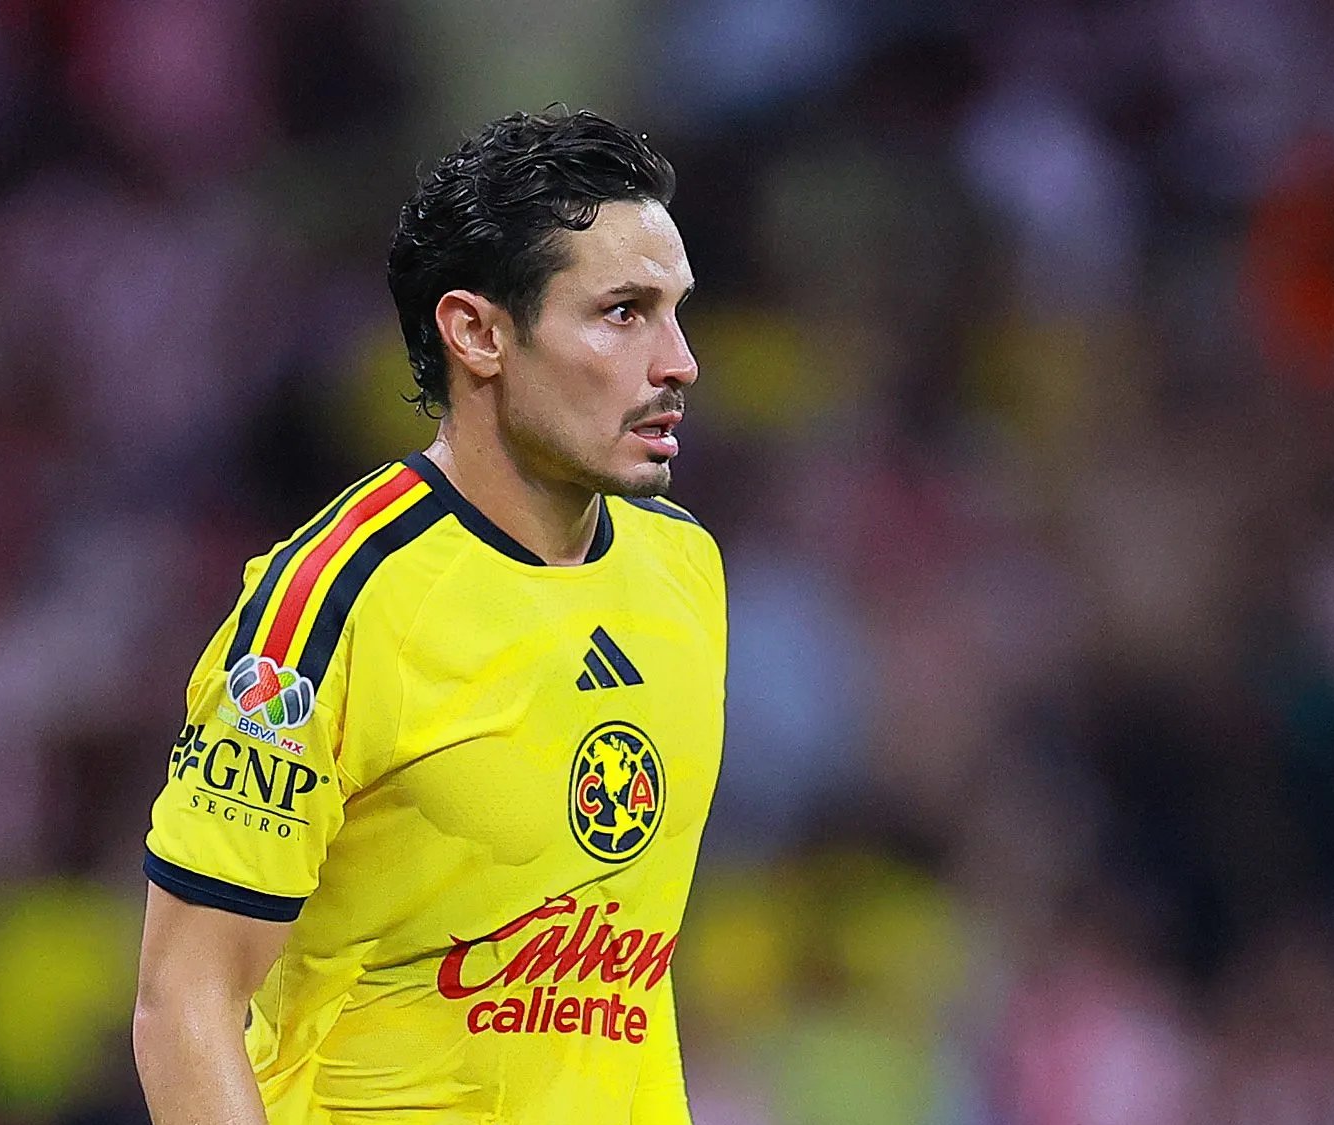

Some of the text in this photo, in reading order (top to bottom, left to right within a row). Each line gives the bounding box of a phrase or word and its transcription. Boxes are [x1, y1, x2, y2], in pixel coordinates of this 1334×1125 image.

[238, 717, 304, 754] BBVA MX
[190, 794, 301, 841] SEGURO
[467, 986, 648, 1044] caliente
